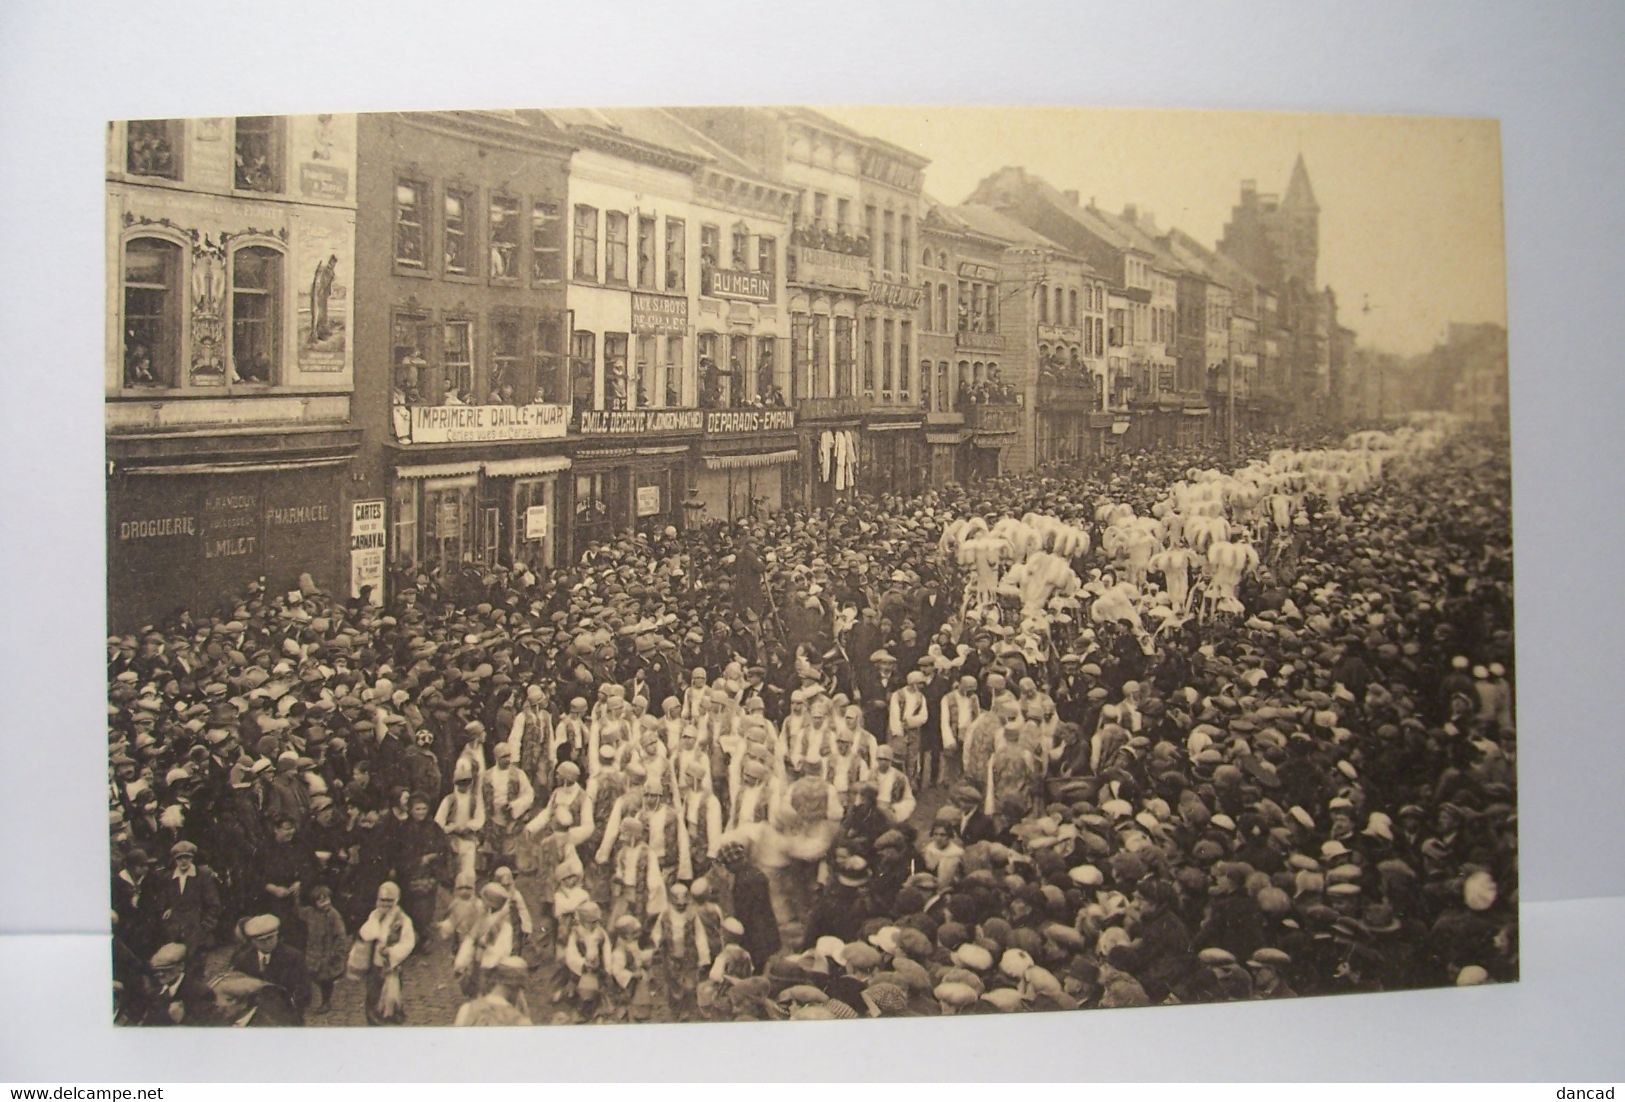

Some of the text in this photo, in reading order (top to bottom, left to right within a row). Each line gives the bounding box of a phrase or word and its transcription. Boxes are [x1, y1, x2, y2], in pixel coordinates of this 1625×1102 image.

[713, 272, 770, 296] AU MARIN
[653, 299, 687, 314] SABOTS
[417, 407, 484, 429] IMPRIMERIE
[581, 411, 609, 433] EMILE
[707, 410, 795, 433] DEPARADIS-EMPAIN
[266, 504, 329, 525] PHARMACIE
[355, 503, 382, 521] CARTES
[352, 532, 384, 551] CARNAVAL
